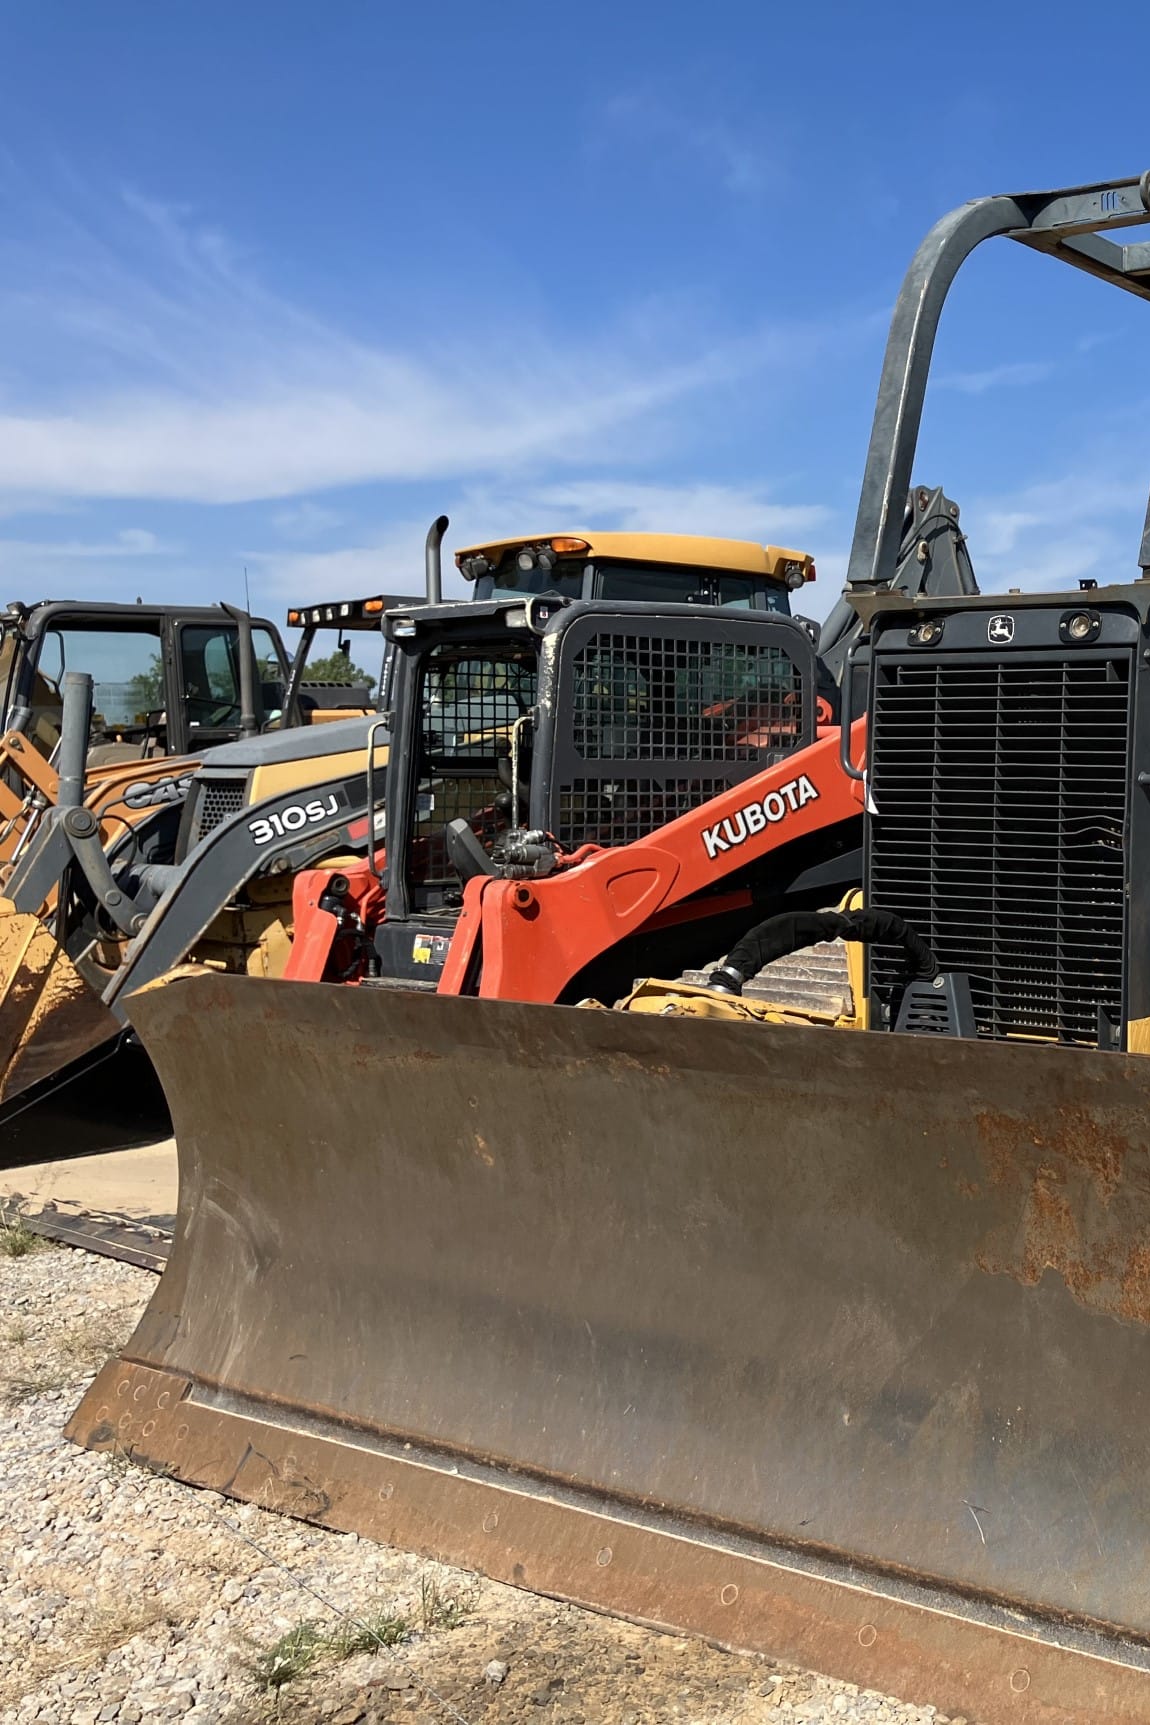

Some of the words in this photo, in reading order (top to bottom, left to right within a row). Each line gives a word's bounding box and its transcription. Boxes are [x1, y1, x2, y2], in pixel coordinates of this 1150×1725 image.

[123, 771, 192, 808] CAS
[249, 795, 339, 845] 310SJ
[701, 774, 819, 858] KUBOTA
